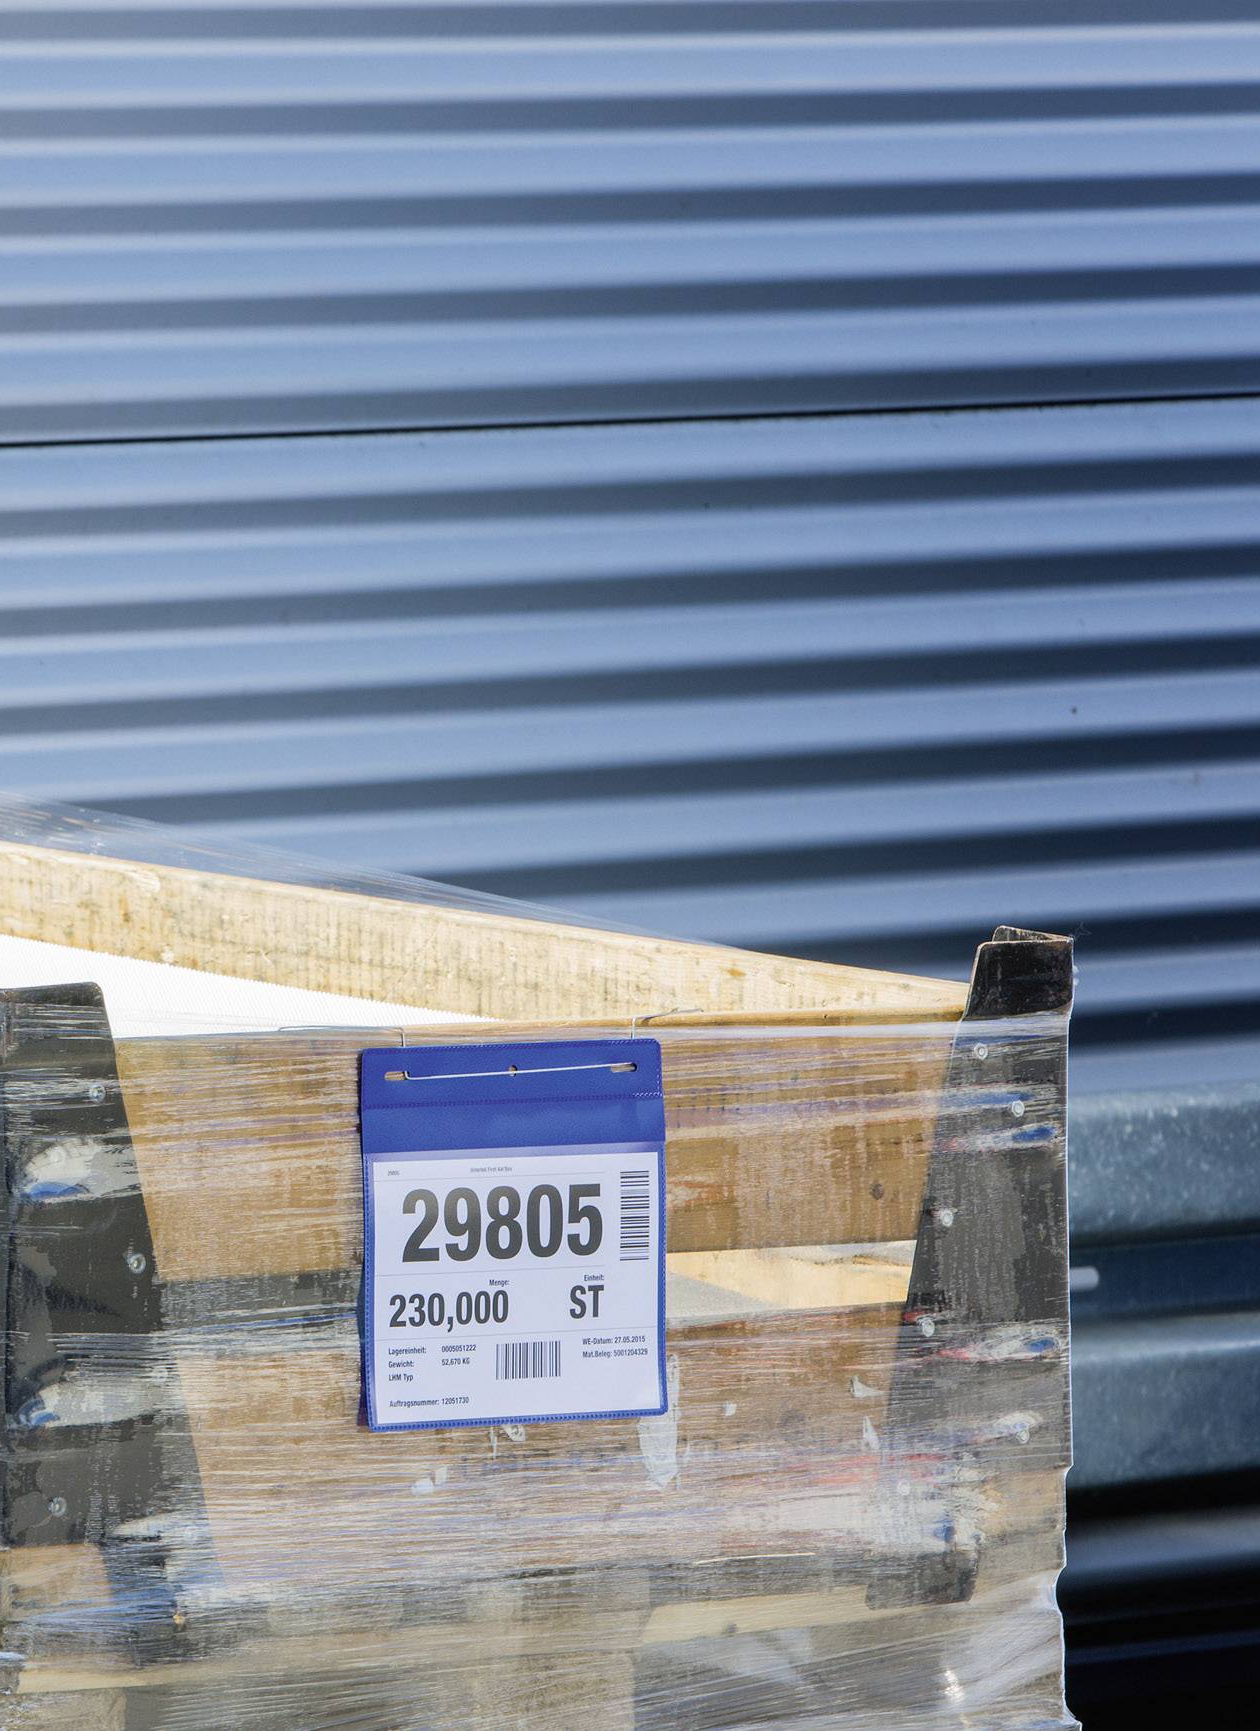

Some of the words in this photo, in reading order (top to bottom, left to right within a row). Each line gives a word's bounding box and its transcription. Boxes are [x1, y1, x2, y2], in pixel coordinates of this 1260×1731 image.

[401, 1183, 604, 1263] 29805
[583, 1273, 605, 1282] Einheit:
[489, 1278, 510, 1288] Menge:
[569, 1284, 605, 1319] ST
[389, 1290, 509, 1332] 230,000
[614, 1335, 646, 1343] 27.05.2015
[388, 1346, 427, 1356] Lagereinheit:
[388, 1360, 414, 1368] Gewicht:
[462, 1357, 470, 1365] KG
[388, 1374, 401, 1382] LHM
[403, 1373, 414, 1382] Typ
[389, 1398, 440, 1408] Auftragsnummer:
